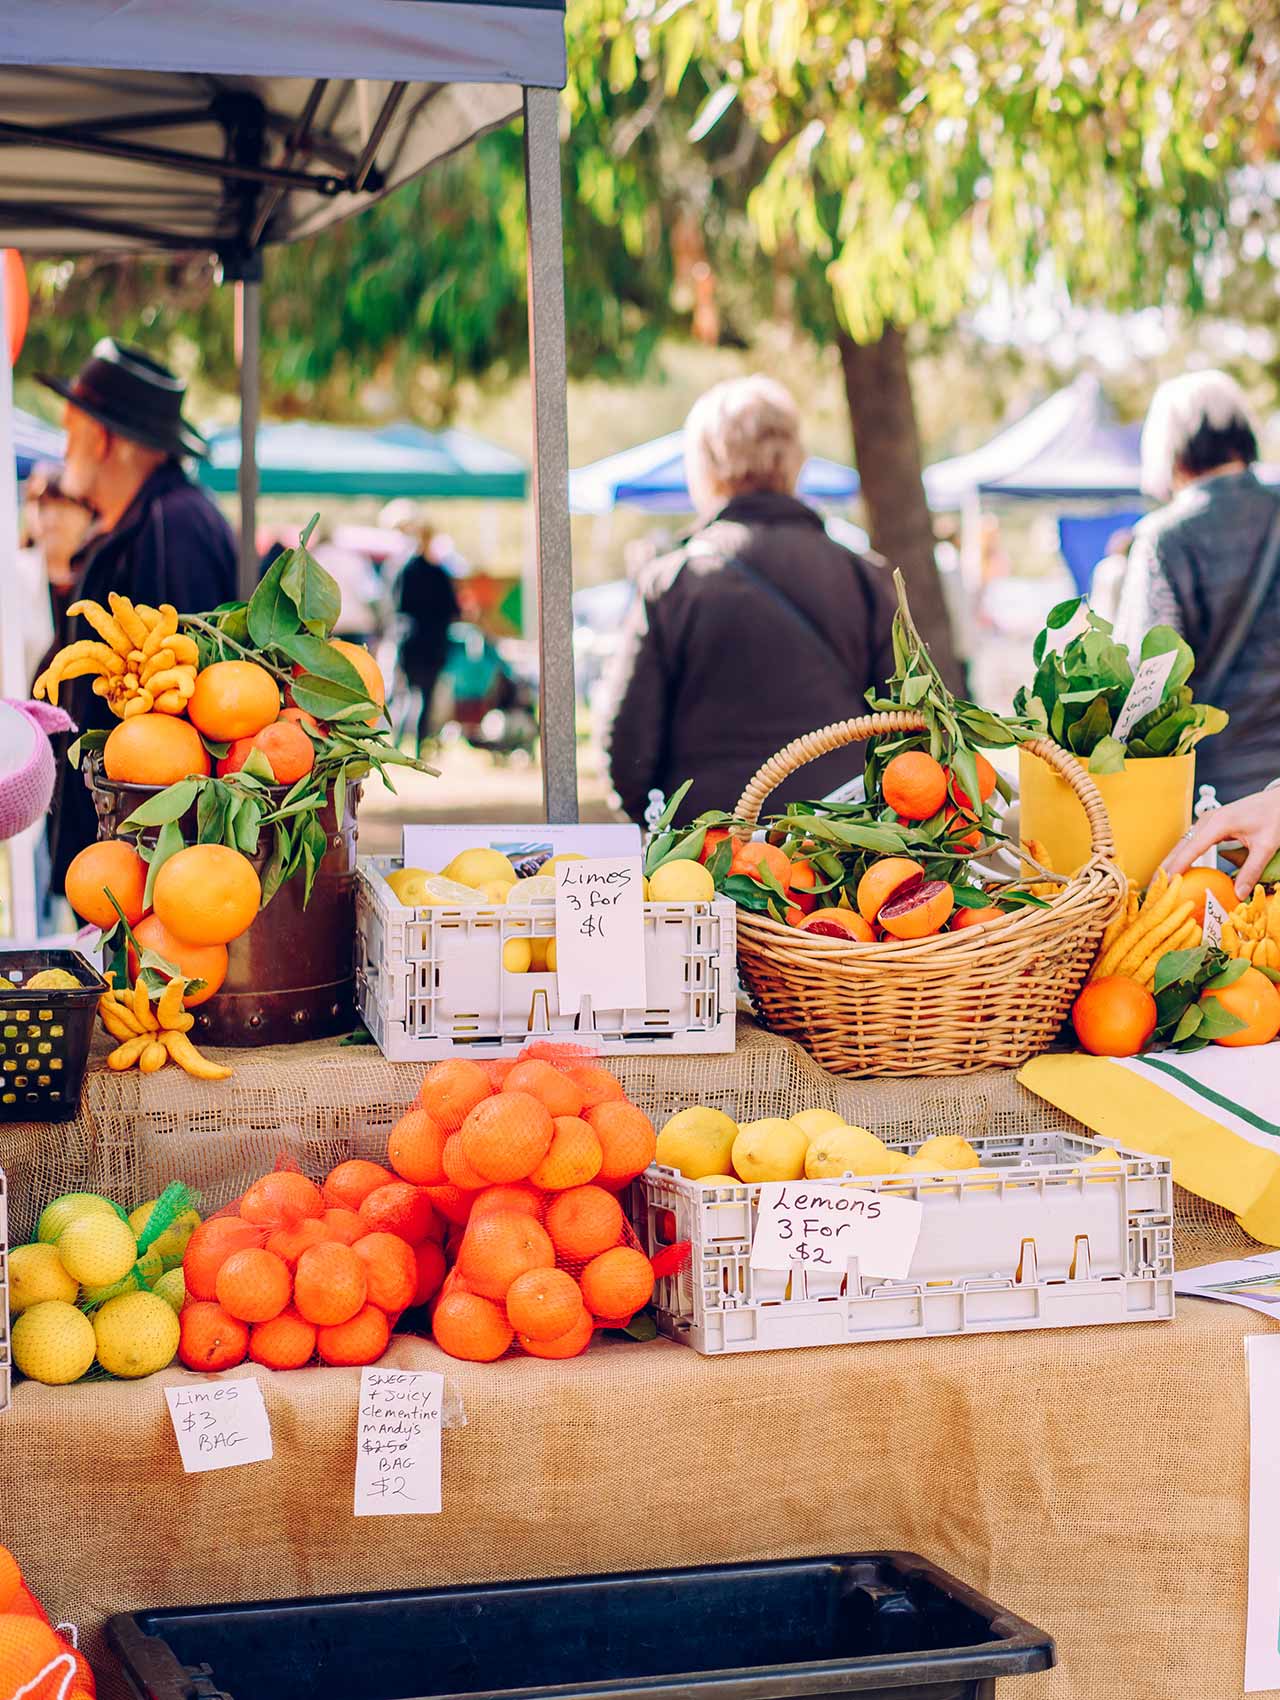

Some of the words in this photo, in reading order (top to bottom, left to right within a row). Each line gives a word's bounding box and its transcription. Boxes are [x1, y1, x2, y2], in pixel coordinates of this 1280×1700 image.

[561, 865, 632, 888] Limes
[566, 895, 582, 911] 3
[580, 914, 605, 937] $1
[773, 1187, 881, 1219] Lemons
[777, 1218, 794, 1240] 3
[789, 1242, 832, 1264] $2
[175, 1386, 239, 1408] Limes
[181, 1411, 217, 1432] $3
[199, 1431, 249, 1452] BAG
[379, 1457, 416, 1472] BAG
[366, 1476, 417, 1501] $2
